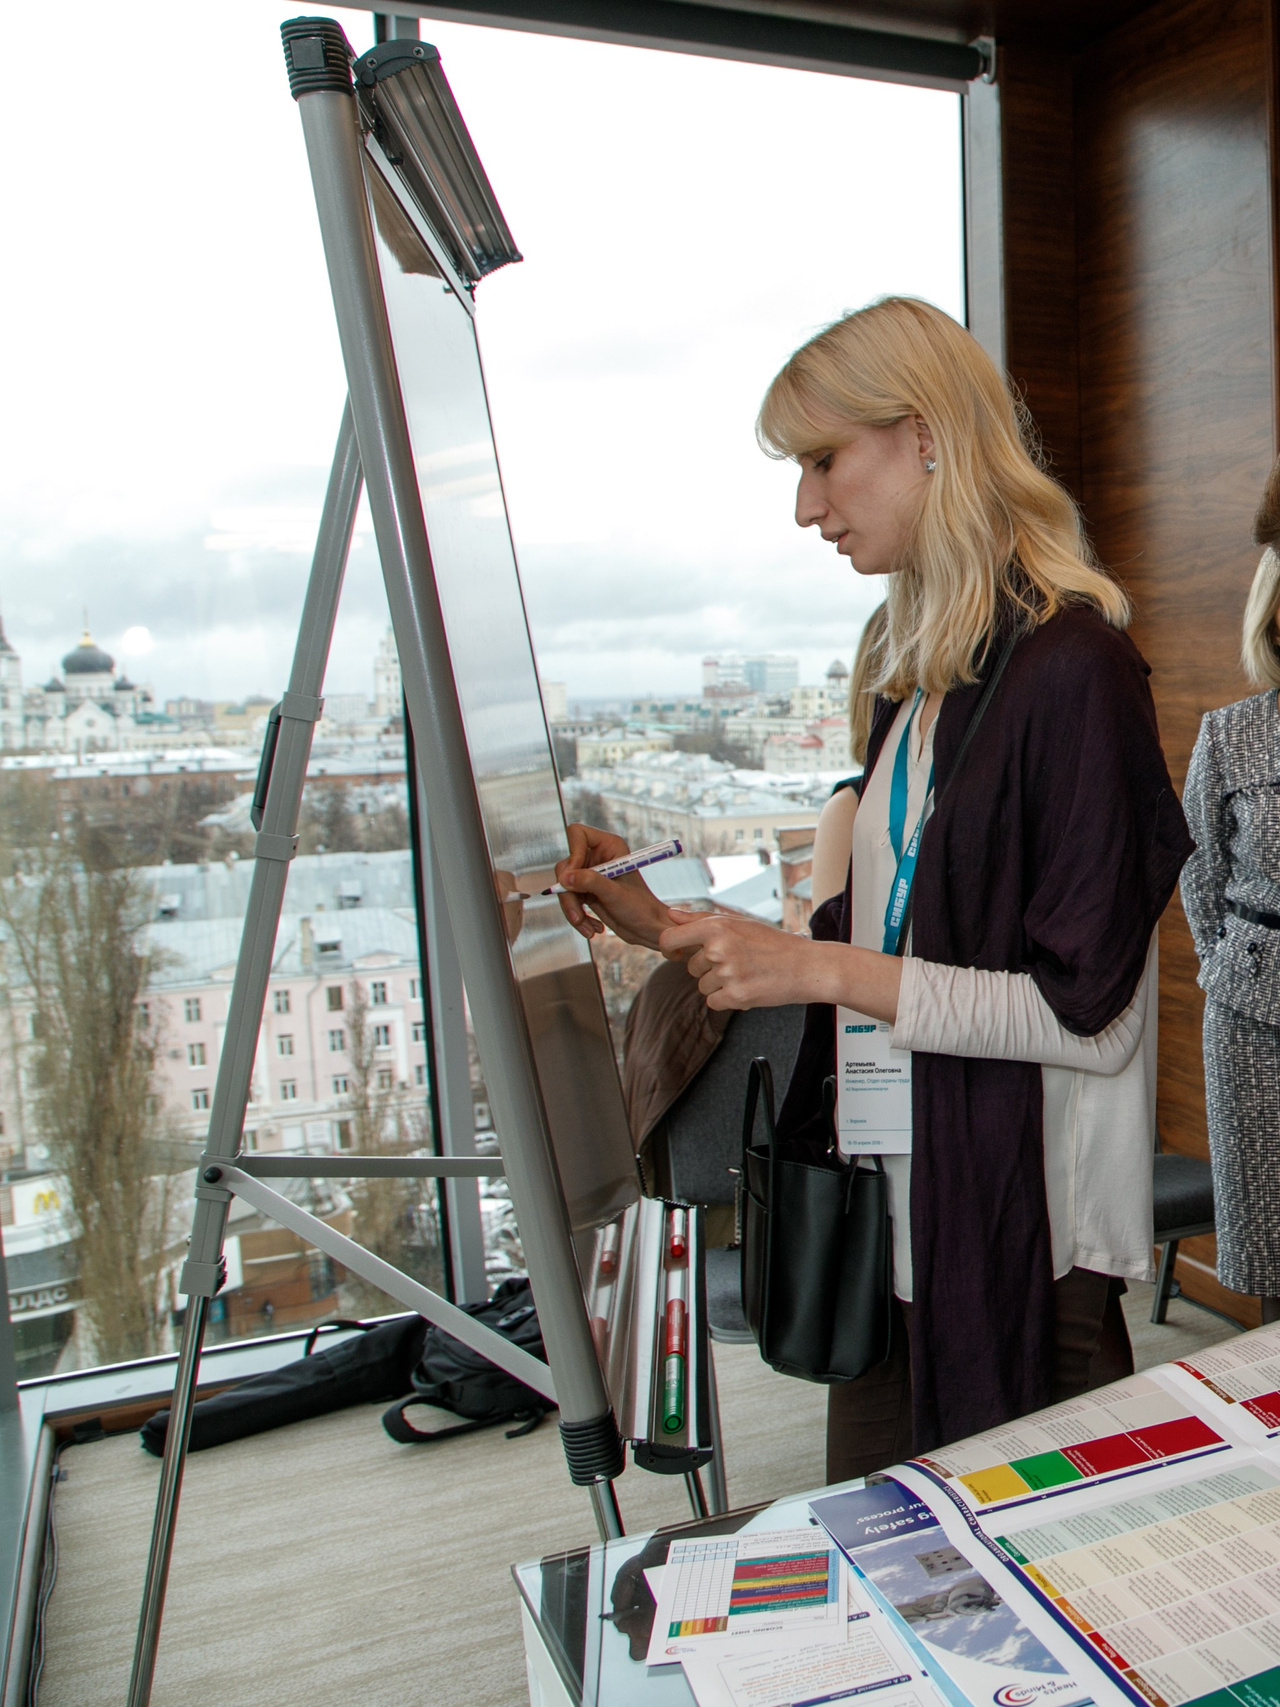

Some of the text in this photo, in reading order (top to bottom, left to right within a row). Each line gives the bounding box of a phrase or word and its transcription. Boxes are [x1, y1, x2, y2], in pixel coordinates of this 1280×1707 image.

[890, 878, 909, 928] СИБУР
[845, 1025, 876, 1033] СИБУР
[942, 1485, 977, 1526] CHARACTERISTICS
[864, 1516, 915, 1536] safely
[1014, 1682, 1046, 1698] Minds
[1042, 1680, 1078, 1696] Hearts
